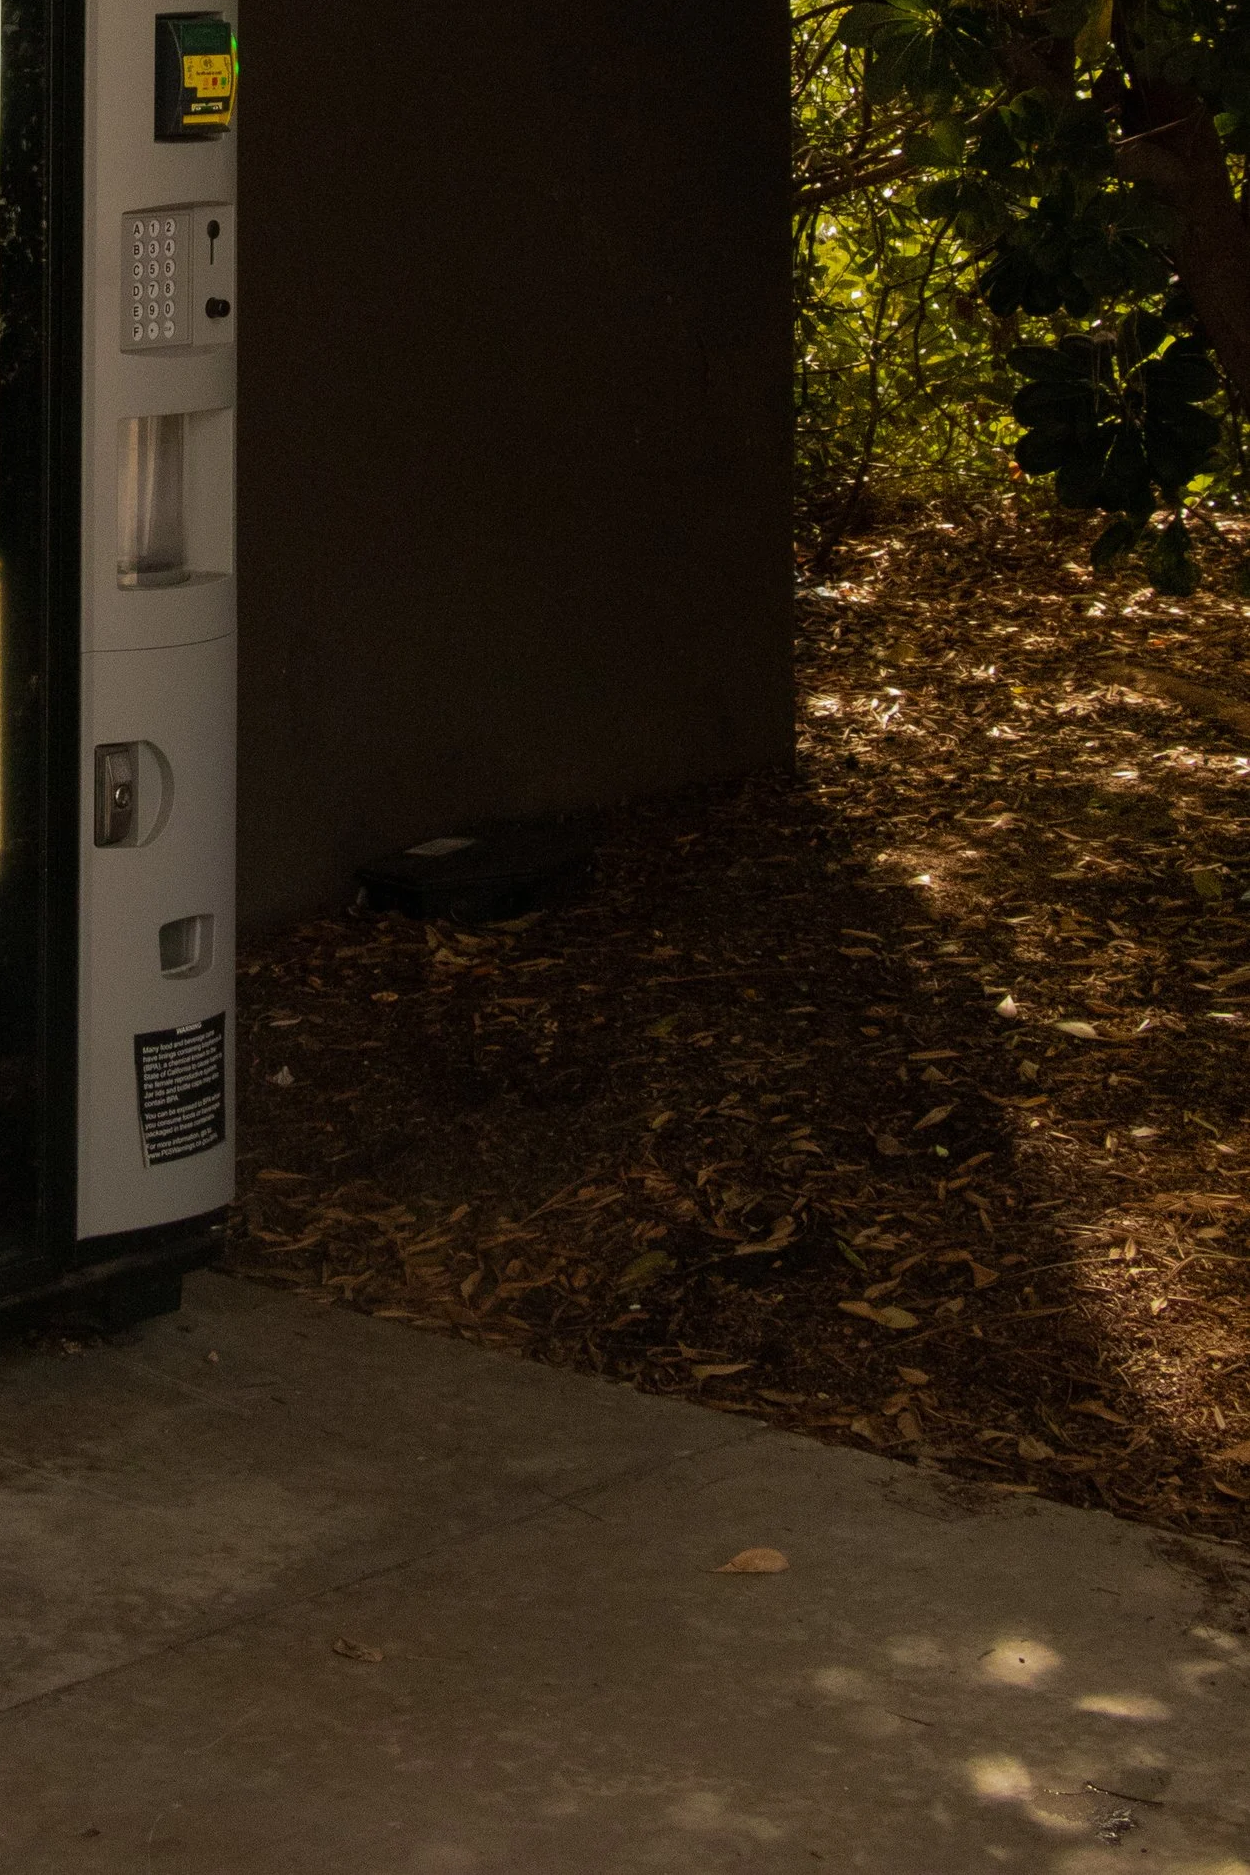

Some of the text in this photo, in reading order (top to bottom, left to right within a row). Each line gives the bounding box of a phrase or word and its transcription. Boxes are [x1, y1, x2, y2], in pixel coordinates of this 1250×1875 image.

[134, 224, 140, 234] A
[166, 221, 172, 232] 2
[134, 241, 171, 255] B 3 4
[134, 263, 171, 275] C 5 6
[133, 283, 171, 297] D 7 8
[134, 306, 139, 317] E
[150, 305, 155, 315] 9
[134, 327, 139, 337] F
